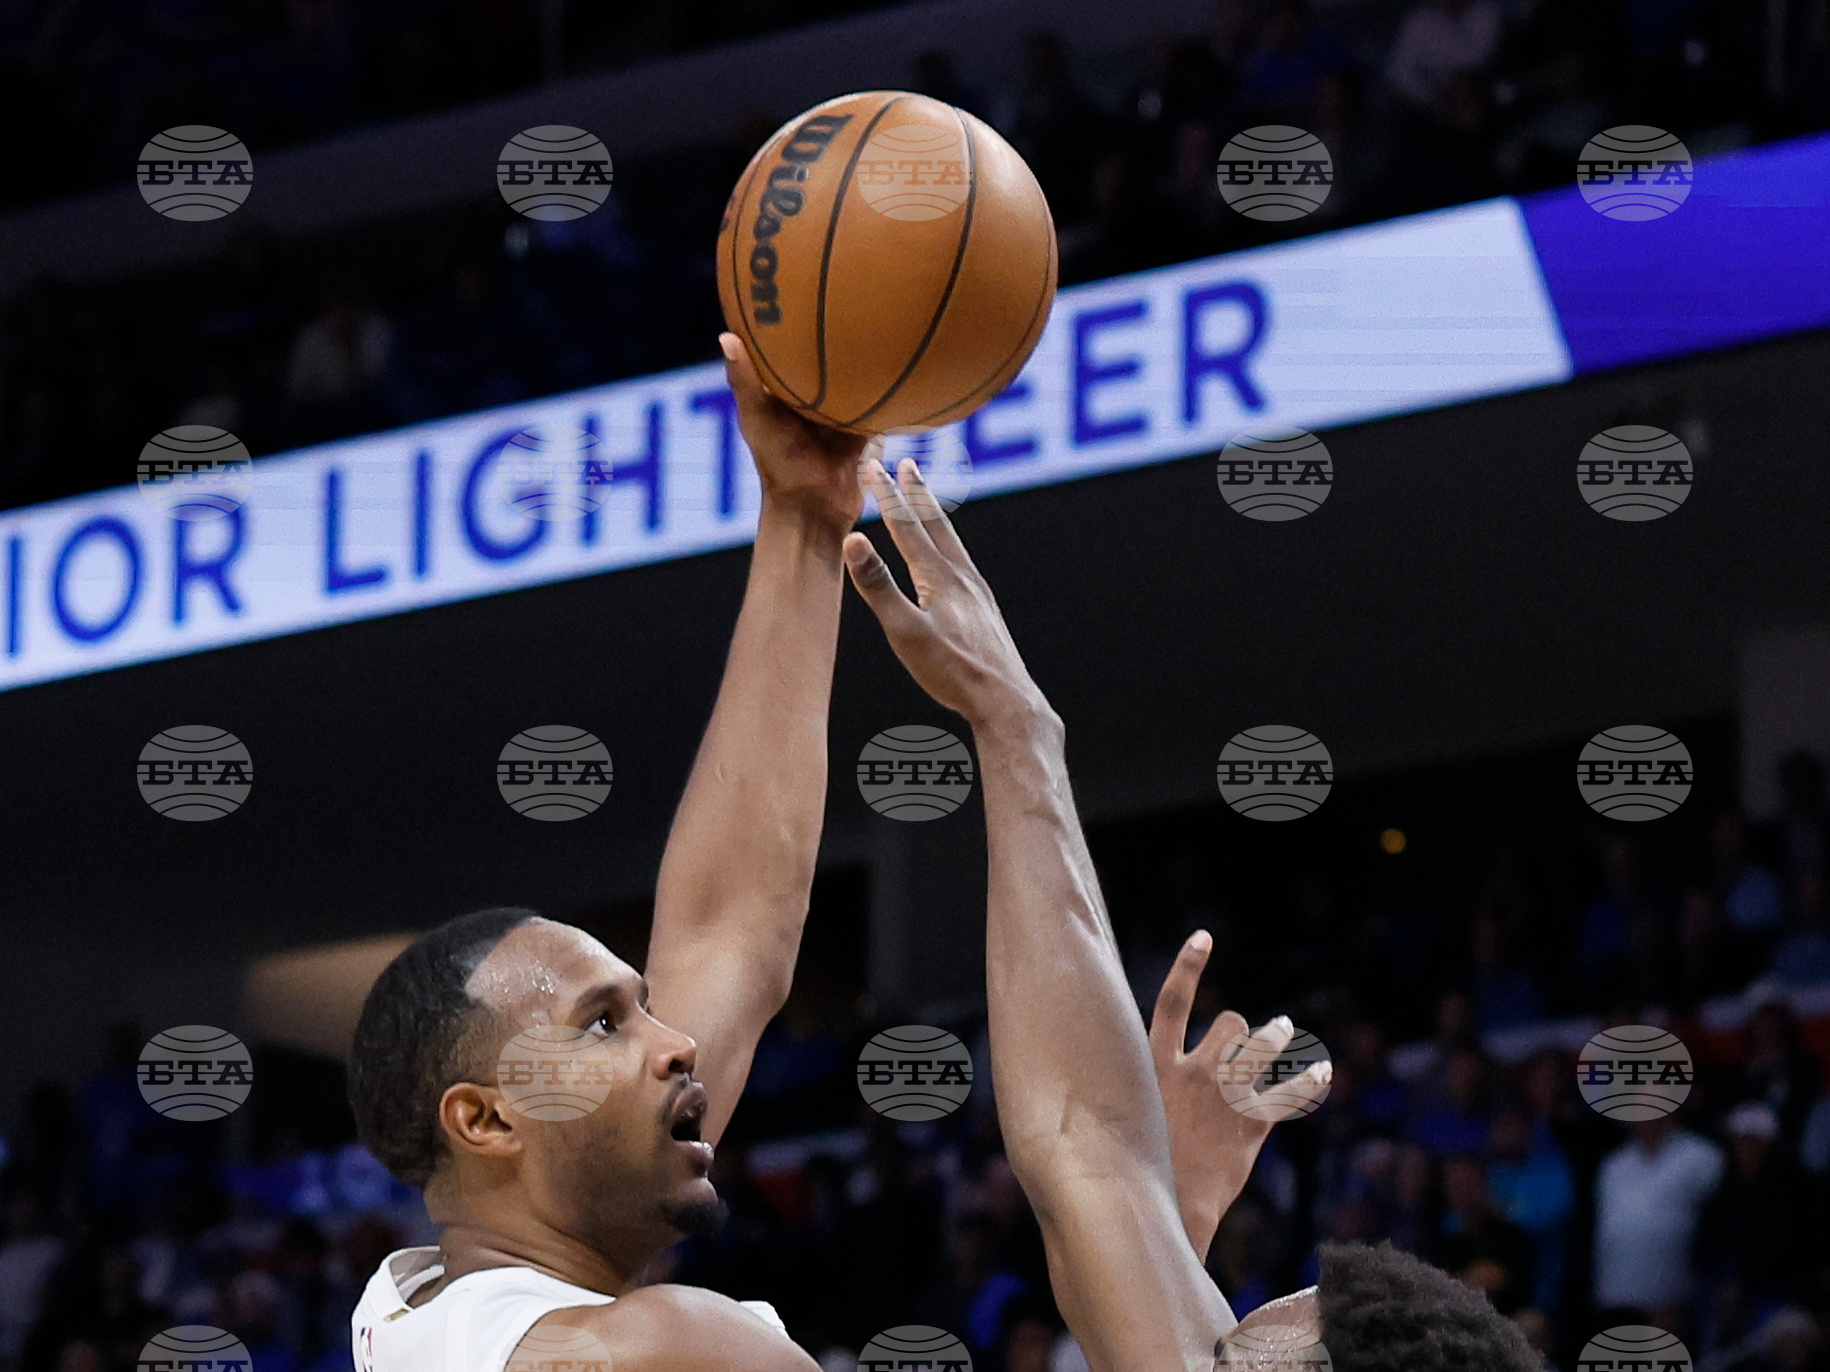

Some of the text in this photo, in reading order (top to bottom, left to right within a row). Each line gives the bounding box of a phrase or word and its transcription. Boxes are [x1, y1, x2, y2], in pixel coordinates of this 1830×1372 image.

[750, 113, 854, 326] Wilson
[8, 494, 247, 659] IOR
[325, 388, 738, 594] LIGHT
